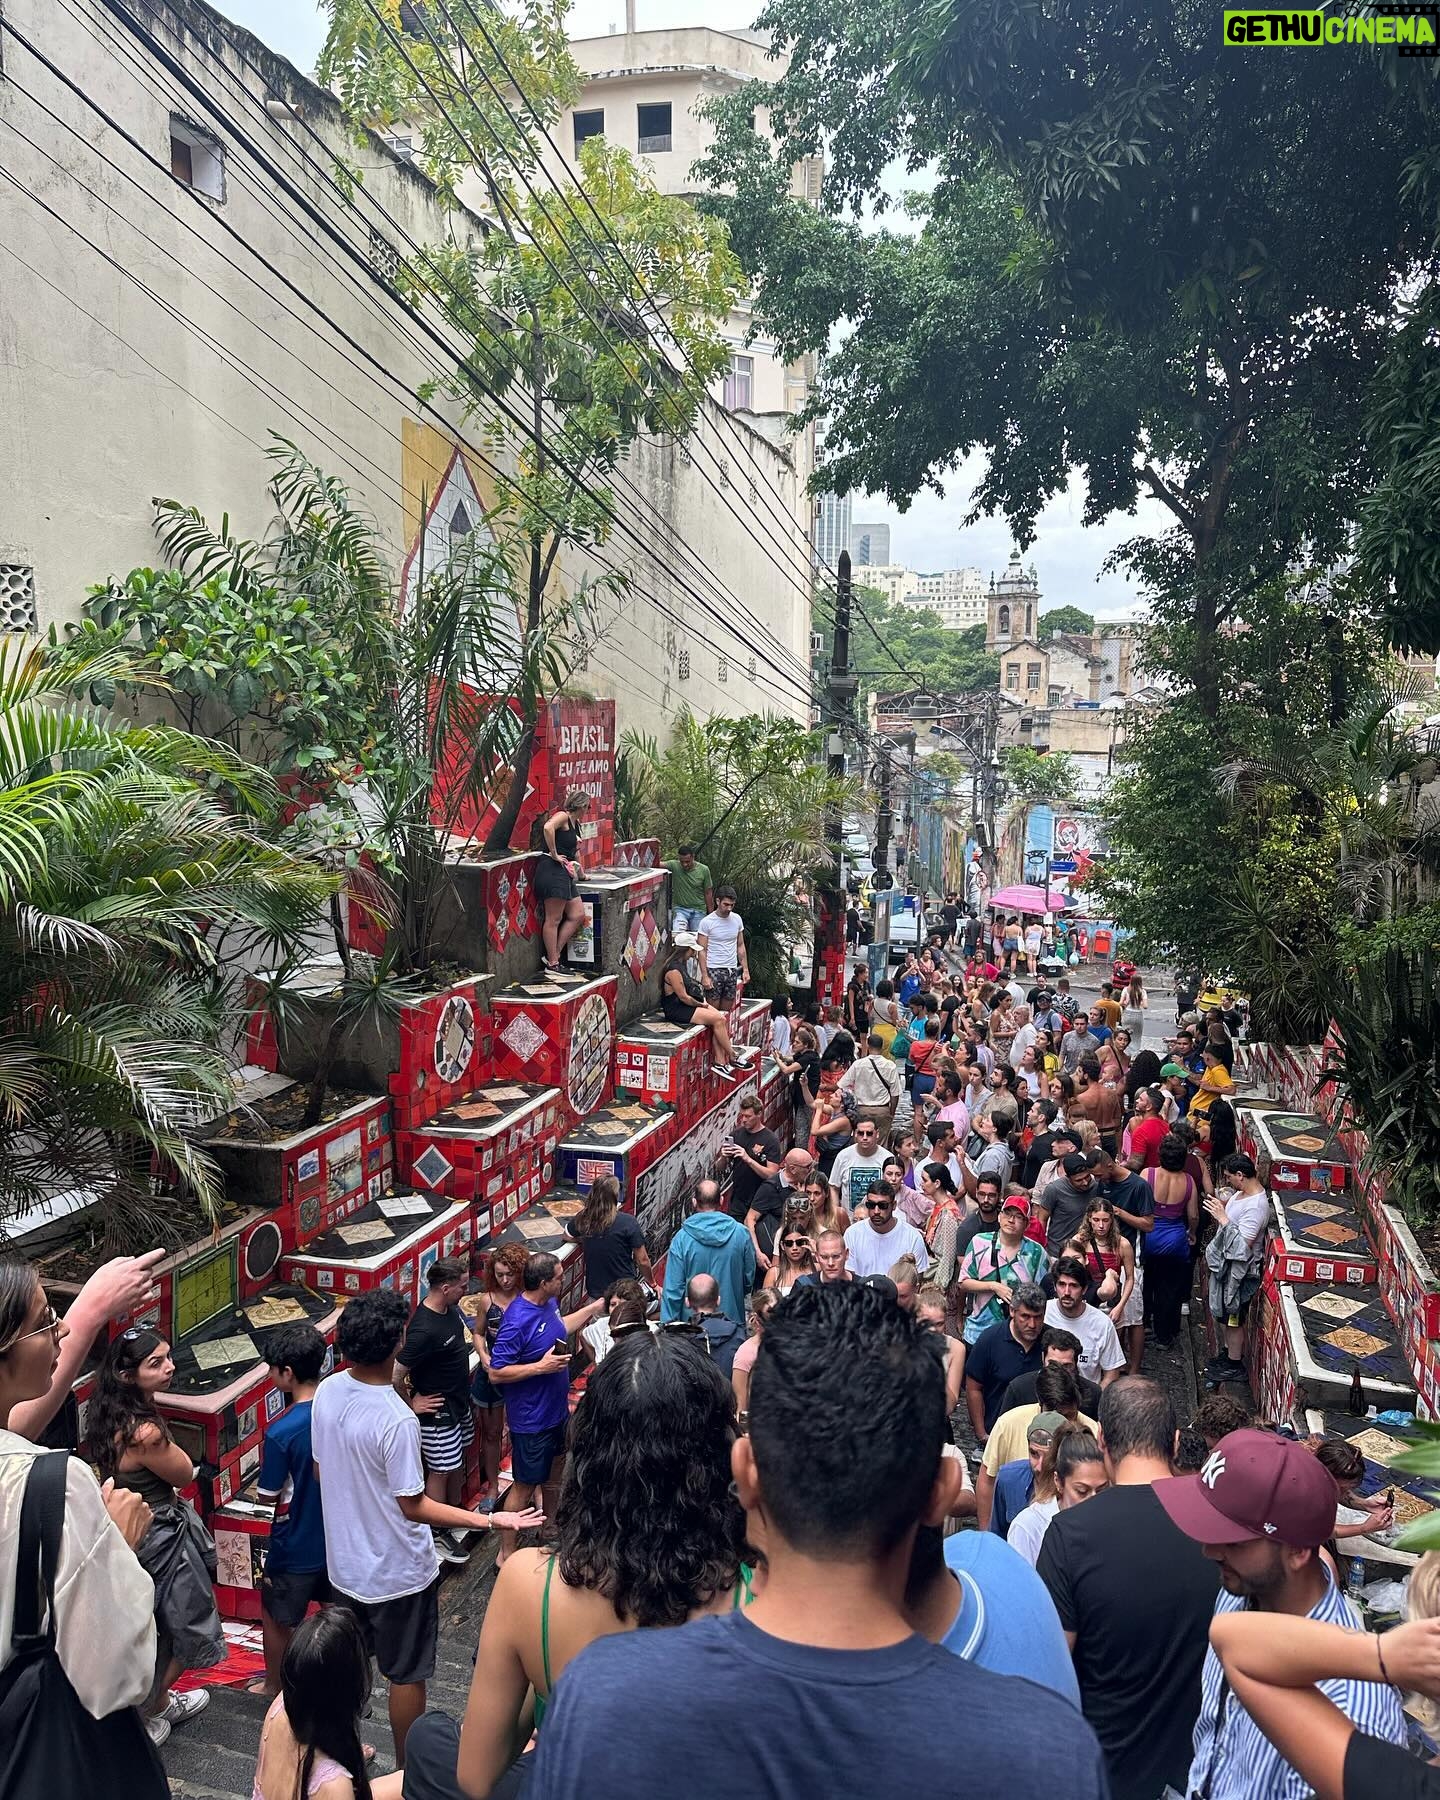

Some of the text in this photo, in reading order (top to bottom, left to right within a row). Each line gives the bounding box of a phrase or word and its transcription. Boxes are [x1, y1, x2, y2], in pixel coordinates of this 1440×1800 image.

[558, 725, 609, 755] BRASIL
[558, 762, 573, 777] EU
[588, 759, 609, 773] AMO
